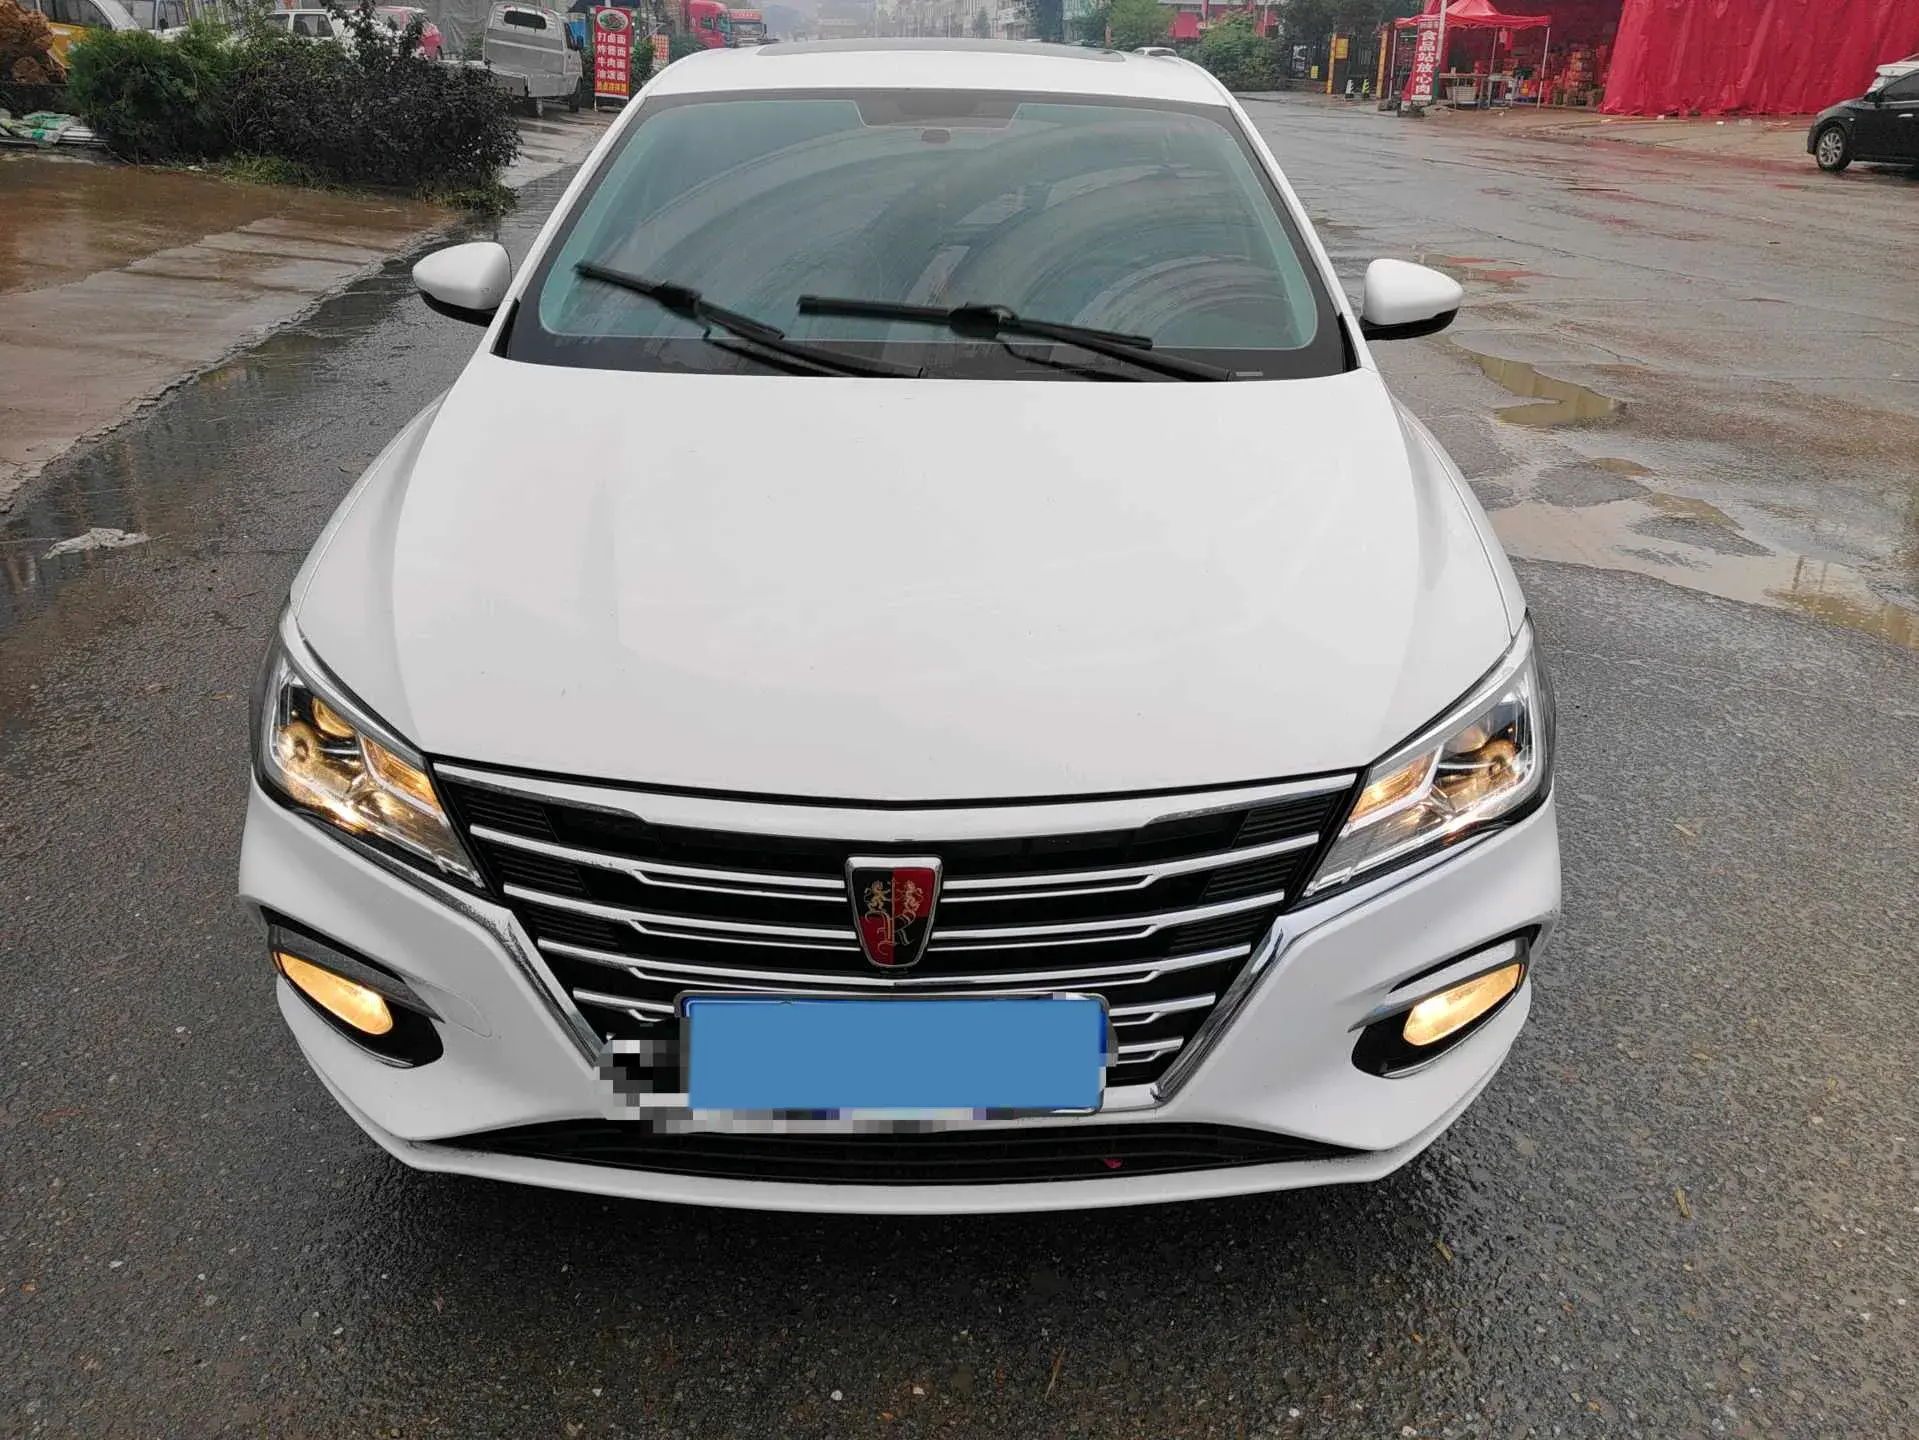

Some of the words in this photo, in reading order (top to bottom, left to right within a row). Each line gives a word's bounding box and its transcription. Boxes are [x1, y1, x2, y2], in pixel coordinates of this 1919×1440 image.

[597, 32, 626, 44] 打卤面
[597, 44, 626, 57] 炸酱面
[597, 57, 626, 69] 牛肉面
[1416, 30, 1437, 94] 食品站放心肉
